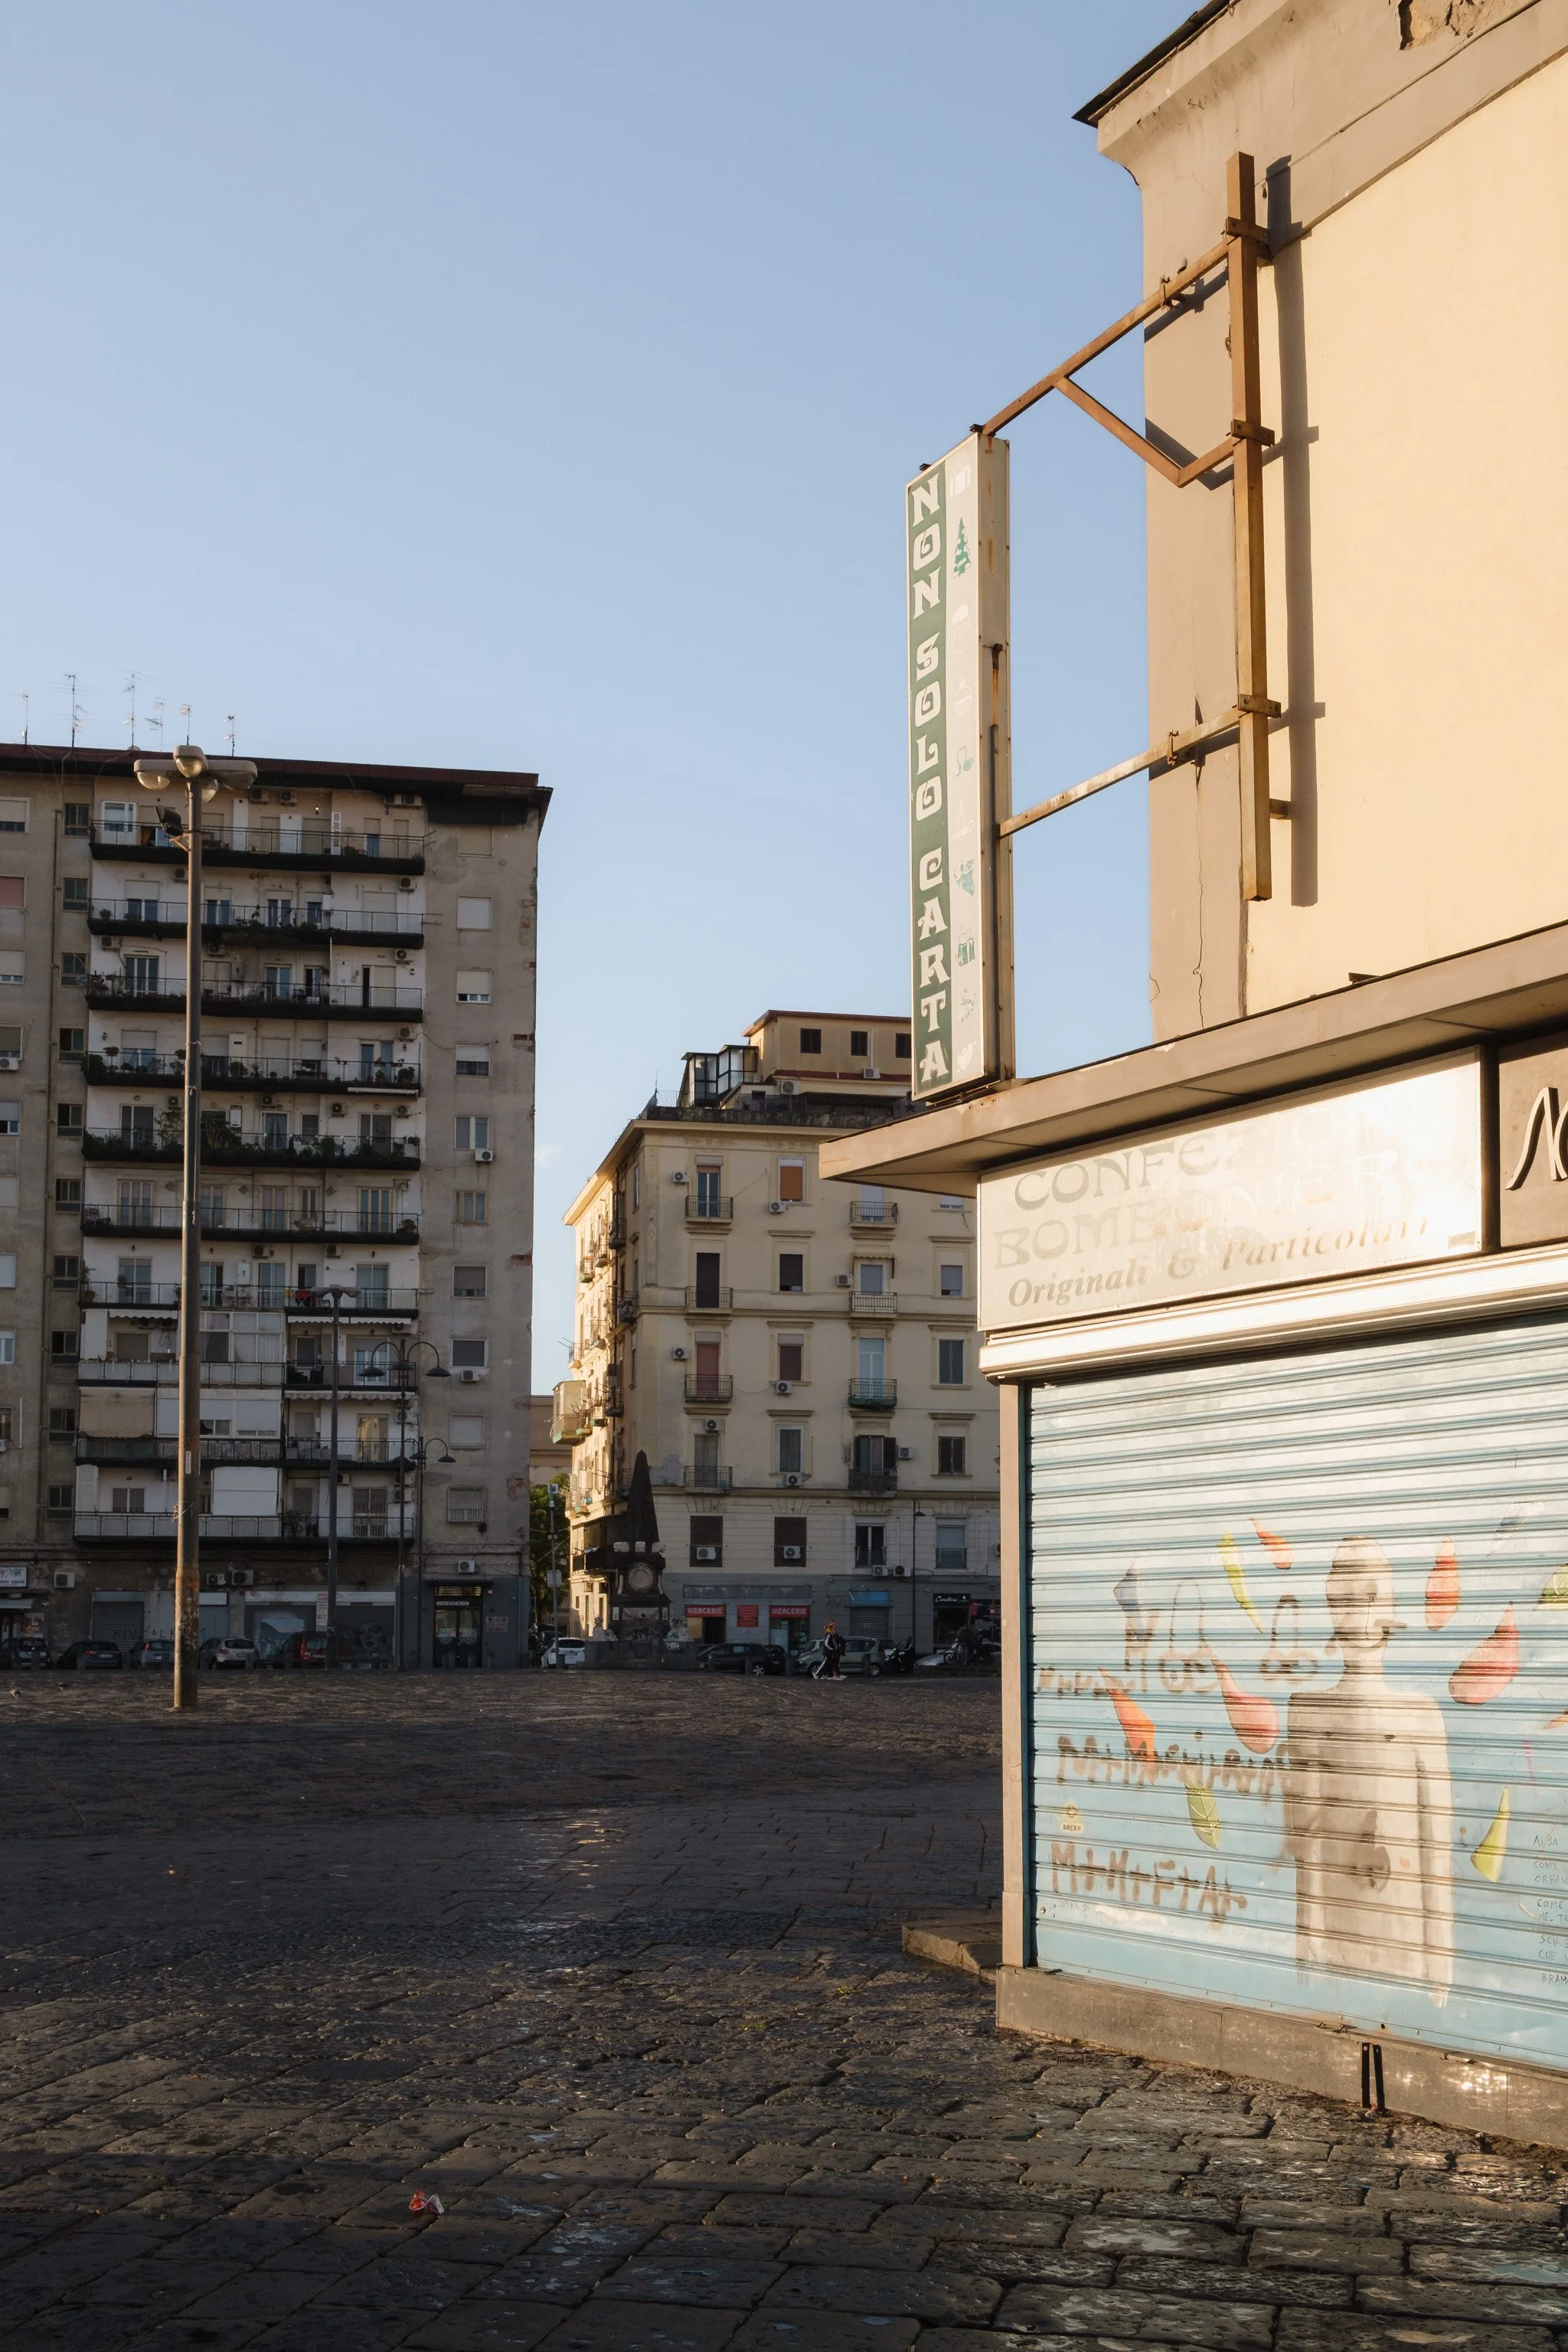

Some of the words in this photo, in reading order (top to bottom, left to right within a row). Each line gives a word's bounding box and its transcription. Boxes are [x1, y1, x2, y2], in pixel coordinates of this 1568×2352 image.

[912, 472, 941, 620] NON
[914, 632, 942, 822] SOLO
[917, 846, 951, 1083] CARTA
[1008, 1254, 1149, 1307] Originali
[1166, 1248, 1199, 1280] &
[1533, 1860, 1559, 1871] COME
[1537, 1898, 1564, 1909] COME
